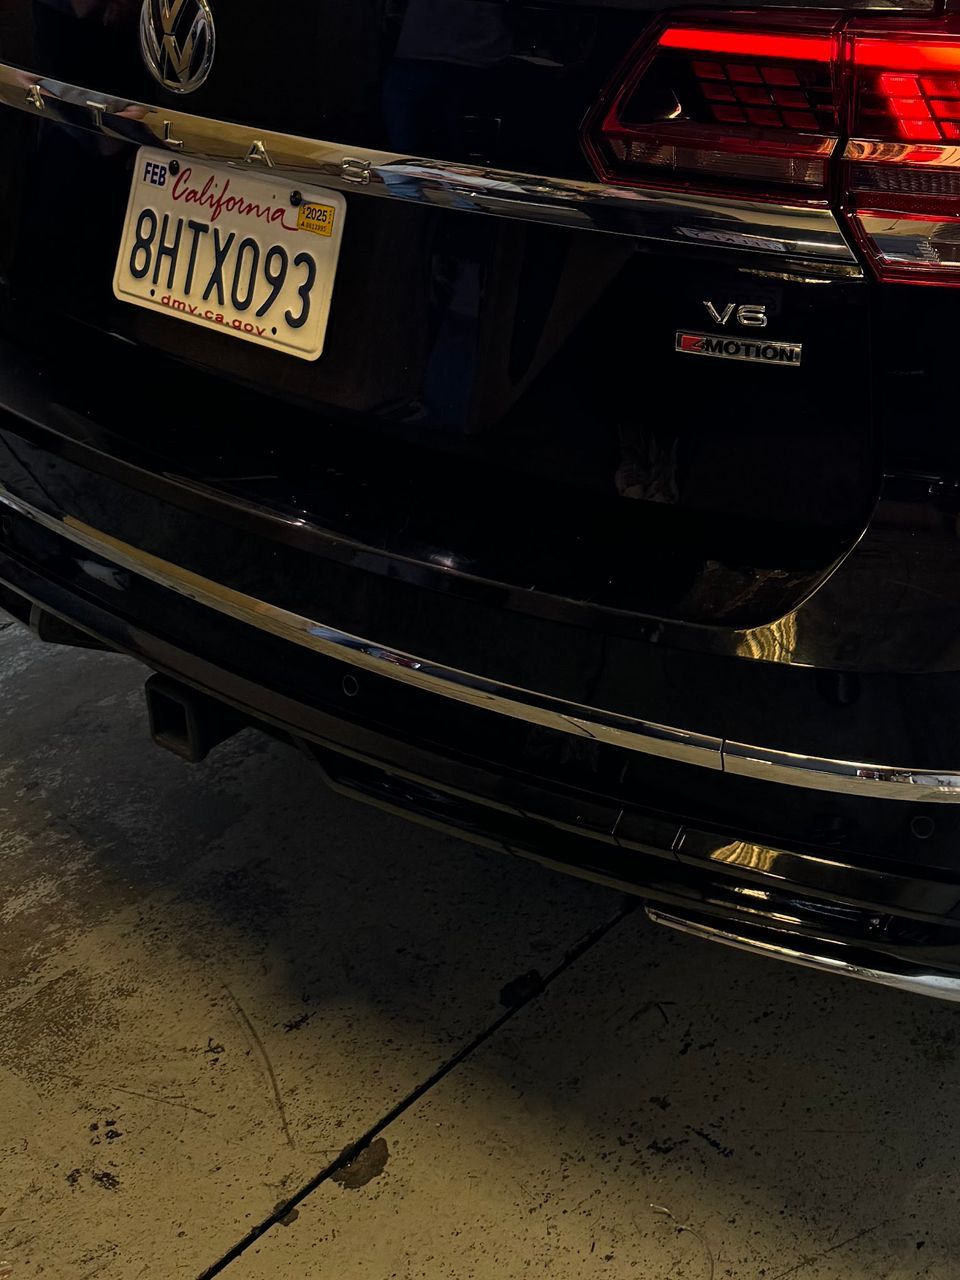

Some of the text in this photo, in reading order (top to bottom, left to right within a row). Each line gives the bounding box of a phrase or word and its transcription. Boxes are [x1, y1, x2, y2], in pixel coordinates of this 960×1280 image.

[143, 162, 168, 187] FEB
[172, 168, 299, 231] California
[305, 207, 328, 222] 2025
[129, 208, 317, 329] 8HTX093
[161, 294, 266, 335] dmv.ca.gov
[702, 300, 768, 327] V6
[682, 334, 795, 362] 4MOTION
